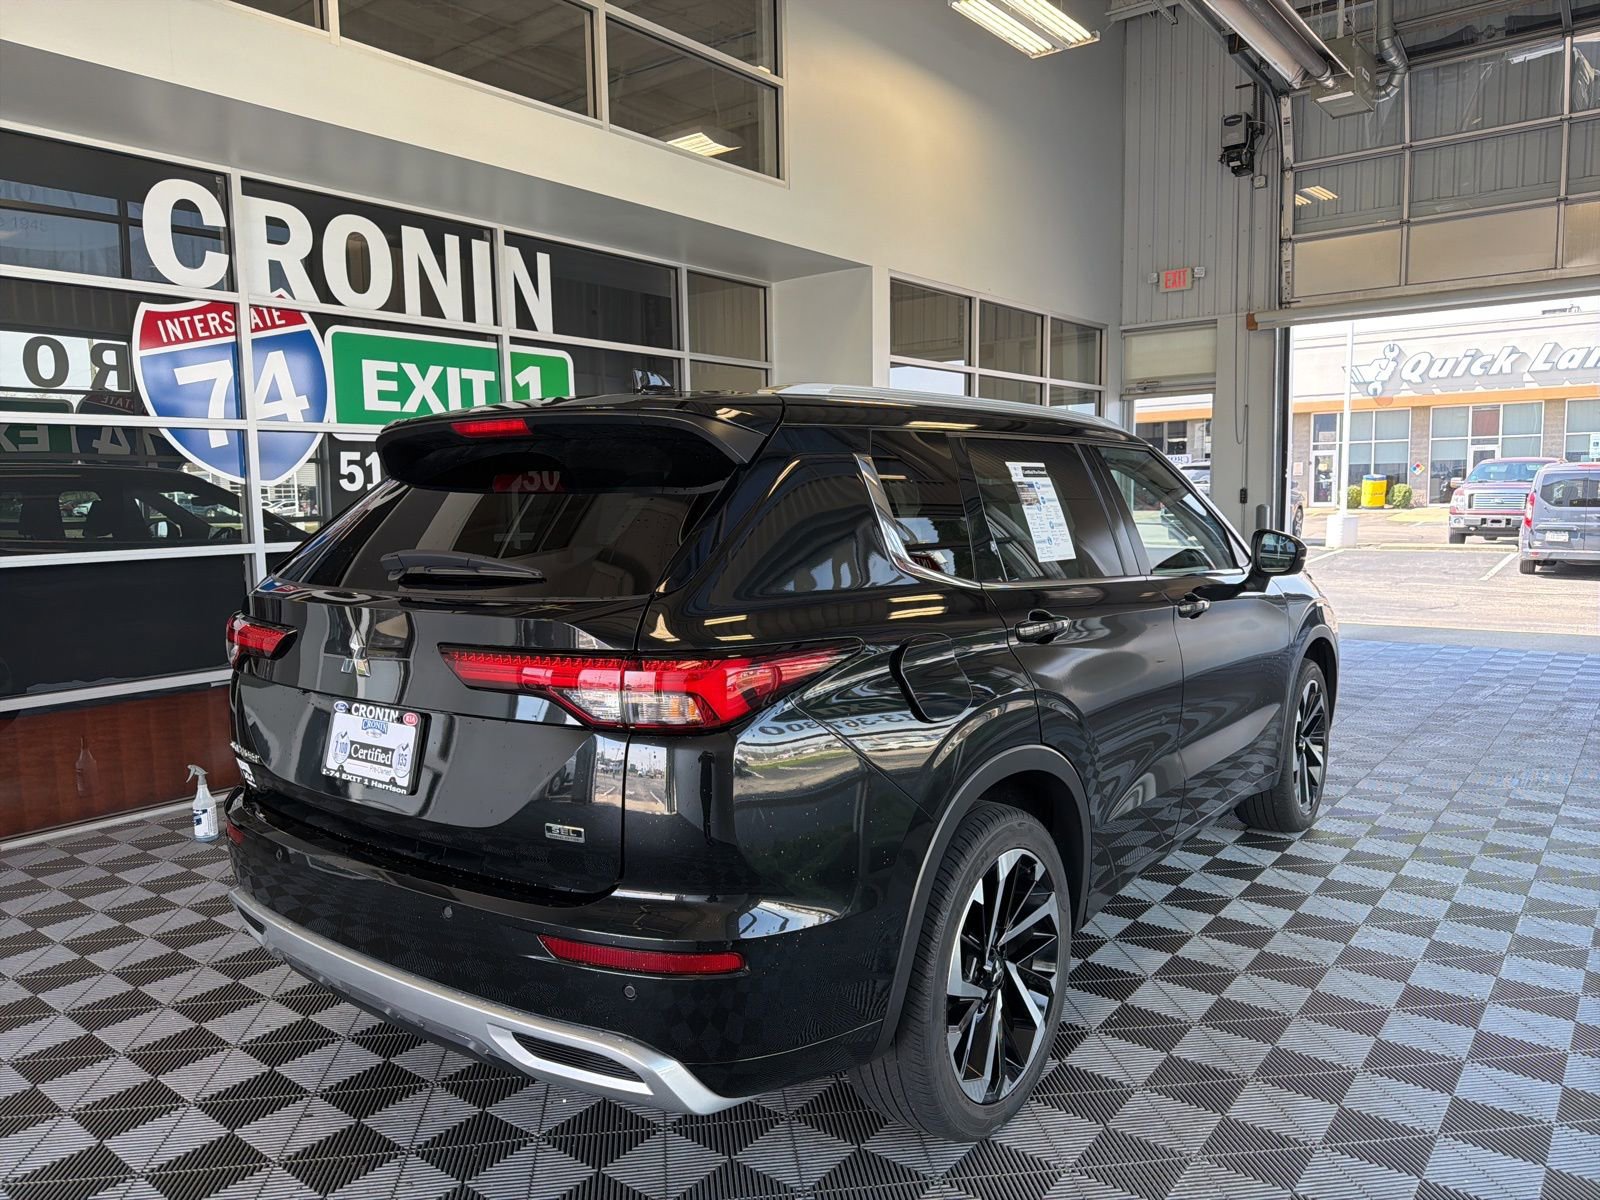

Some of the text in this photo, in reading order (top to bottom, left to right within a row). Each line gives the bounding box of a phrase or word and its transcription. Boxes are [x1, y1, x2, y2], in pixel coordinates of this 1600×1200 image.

[142, 178, 553, 333] CRONIN
[1164, 269, 1187, 289] EXIT
[1400, 344, 1524, 384] Quick
[361, 358, 543, 414] EXIT 1
[173, 350, 310, 449] 74
[351, 703, 399, 724] CRONIN
[362, 719, 388, 734] CRONIN
[350, 743, 392, 765] Certified
[341, 773, 363, 784] EXIT
[371, 780, 407, 795] Harrison
[551, 826, 577, 837] SEL
